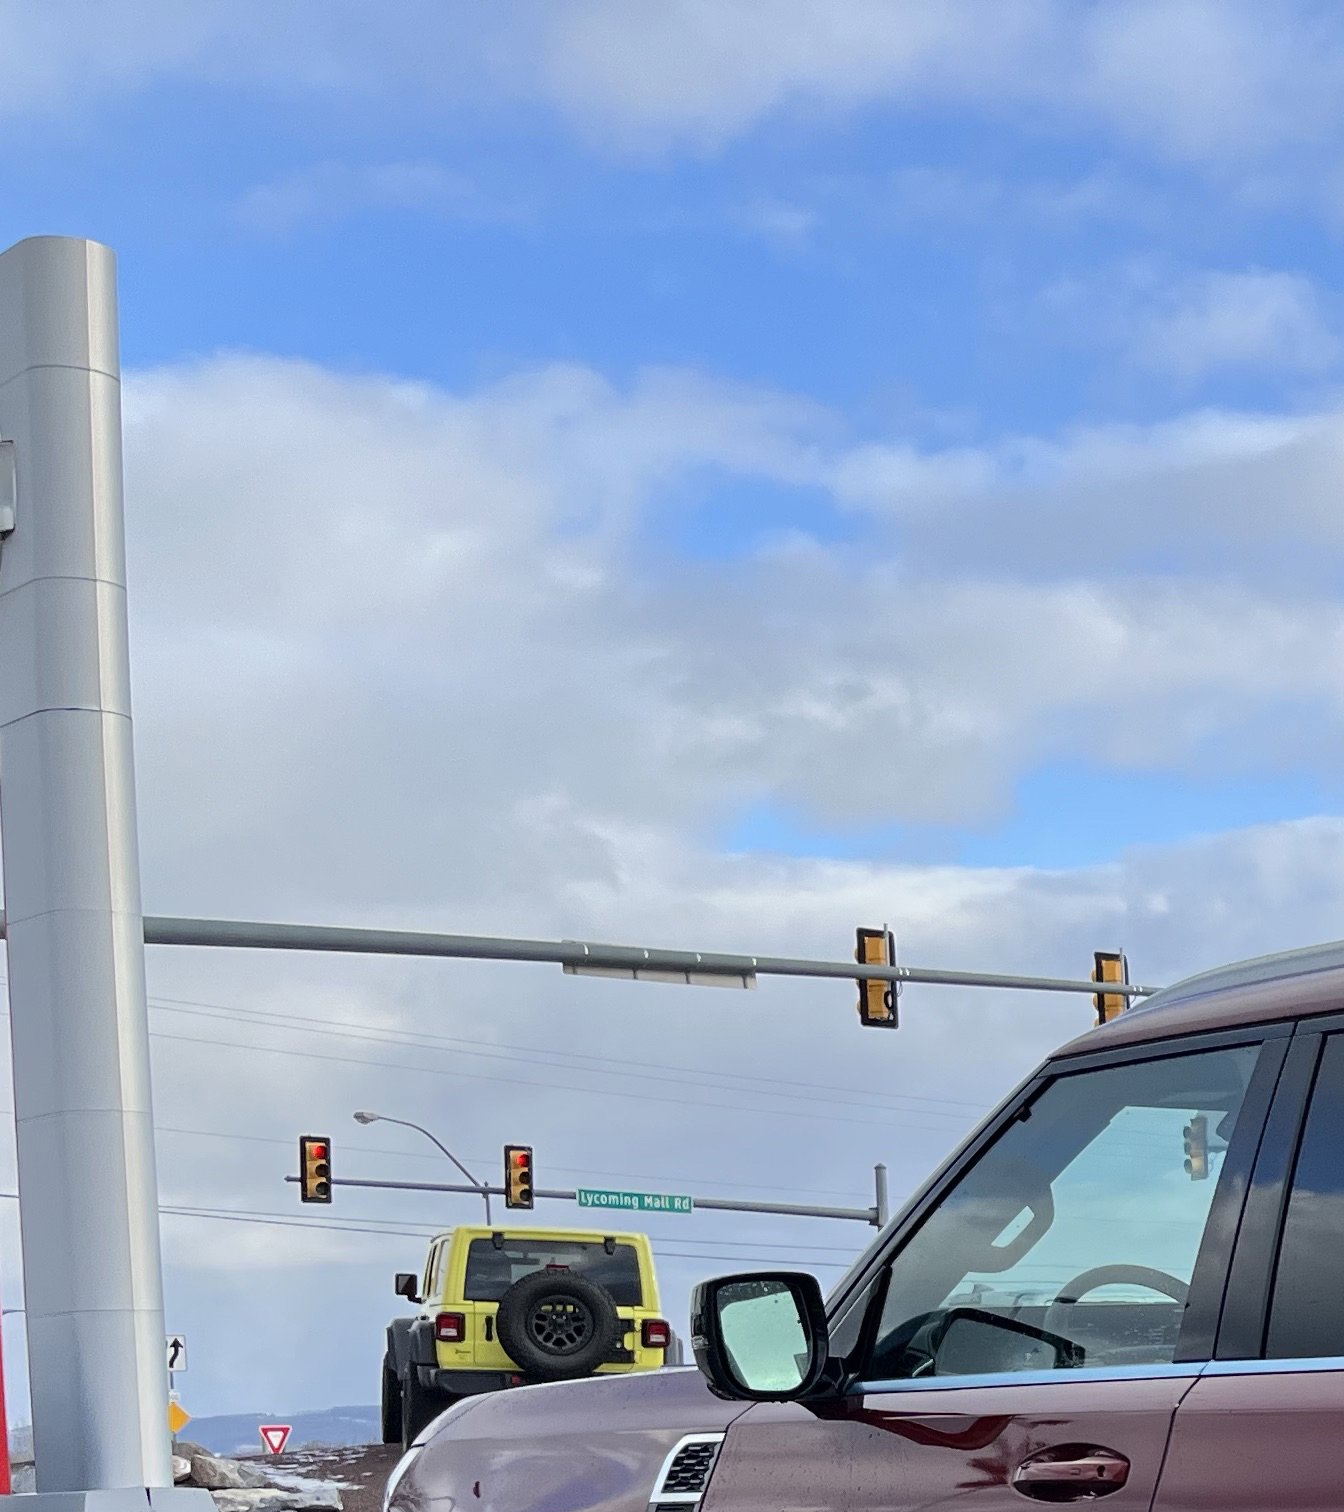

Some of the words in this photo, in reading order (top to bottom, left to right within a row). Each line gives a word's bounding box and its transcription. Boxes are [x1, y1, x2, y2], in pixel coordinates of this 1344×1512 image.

[580, 1190, 639, 1209] Lycoming
[644, 1195, 670, 1209] Mall
[674, 1197, 690, 1210] Rd
